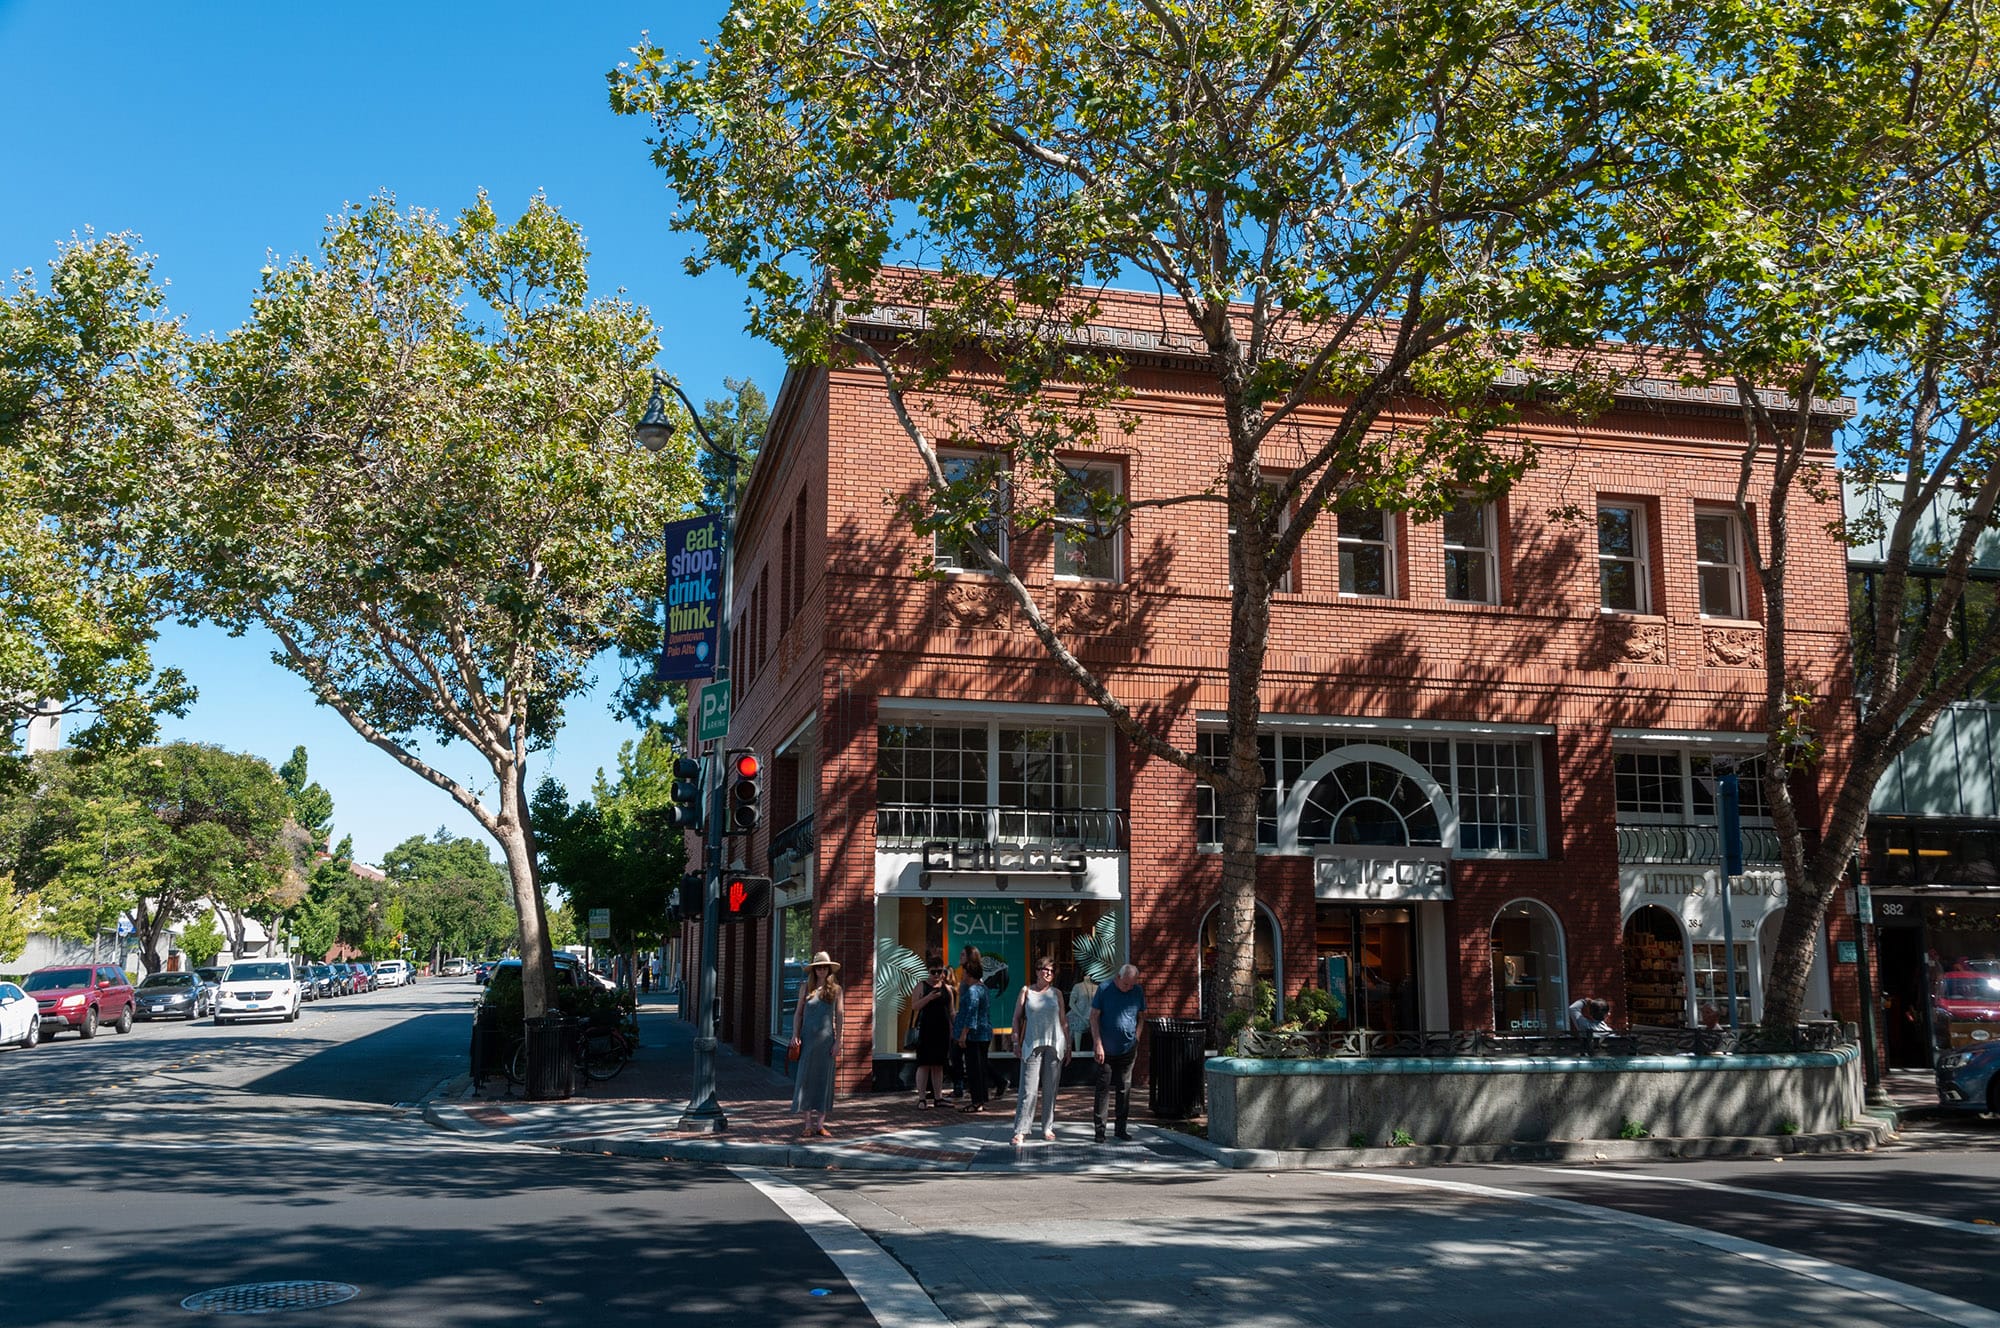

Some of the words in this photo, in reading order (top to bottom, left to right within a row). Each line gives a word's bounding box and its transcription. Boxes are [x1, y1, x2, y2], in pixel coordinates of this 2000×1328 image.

[686, 521, 718, 552] eat.
[671, 547, 717, 577] shop.
[668, 570, 716, 606] drink.
[669, 600, 715, 633] think.
[669, 631, 705, 645] Downtown
[667, 645, 681, 658] Palo
[681, 643, 696, 656] Alto
[1643, 872, 1706, 897] LETTER
[1714, 874, 1786, 898] PERFEC
[1882, 903, 1905, 916] 382
[953, 913, 1020, 936] SALE
[1688, 918, 1703, 929] 384
[1740, 918, 1755, 929] 394
